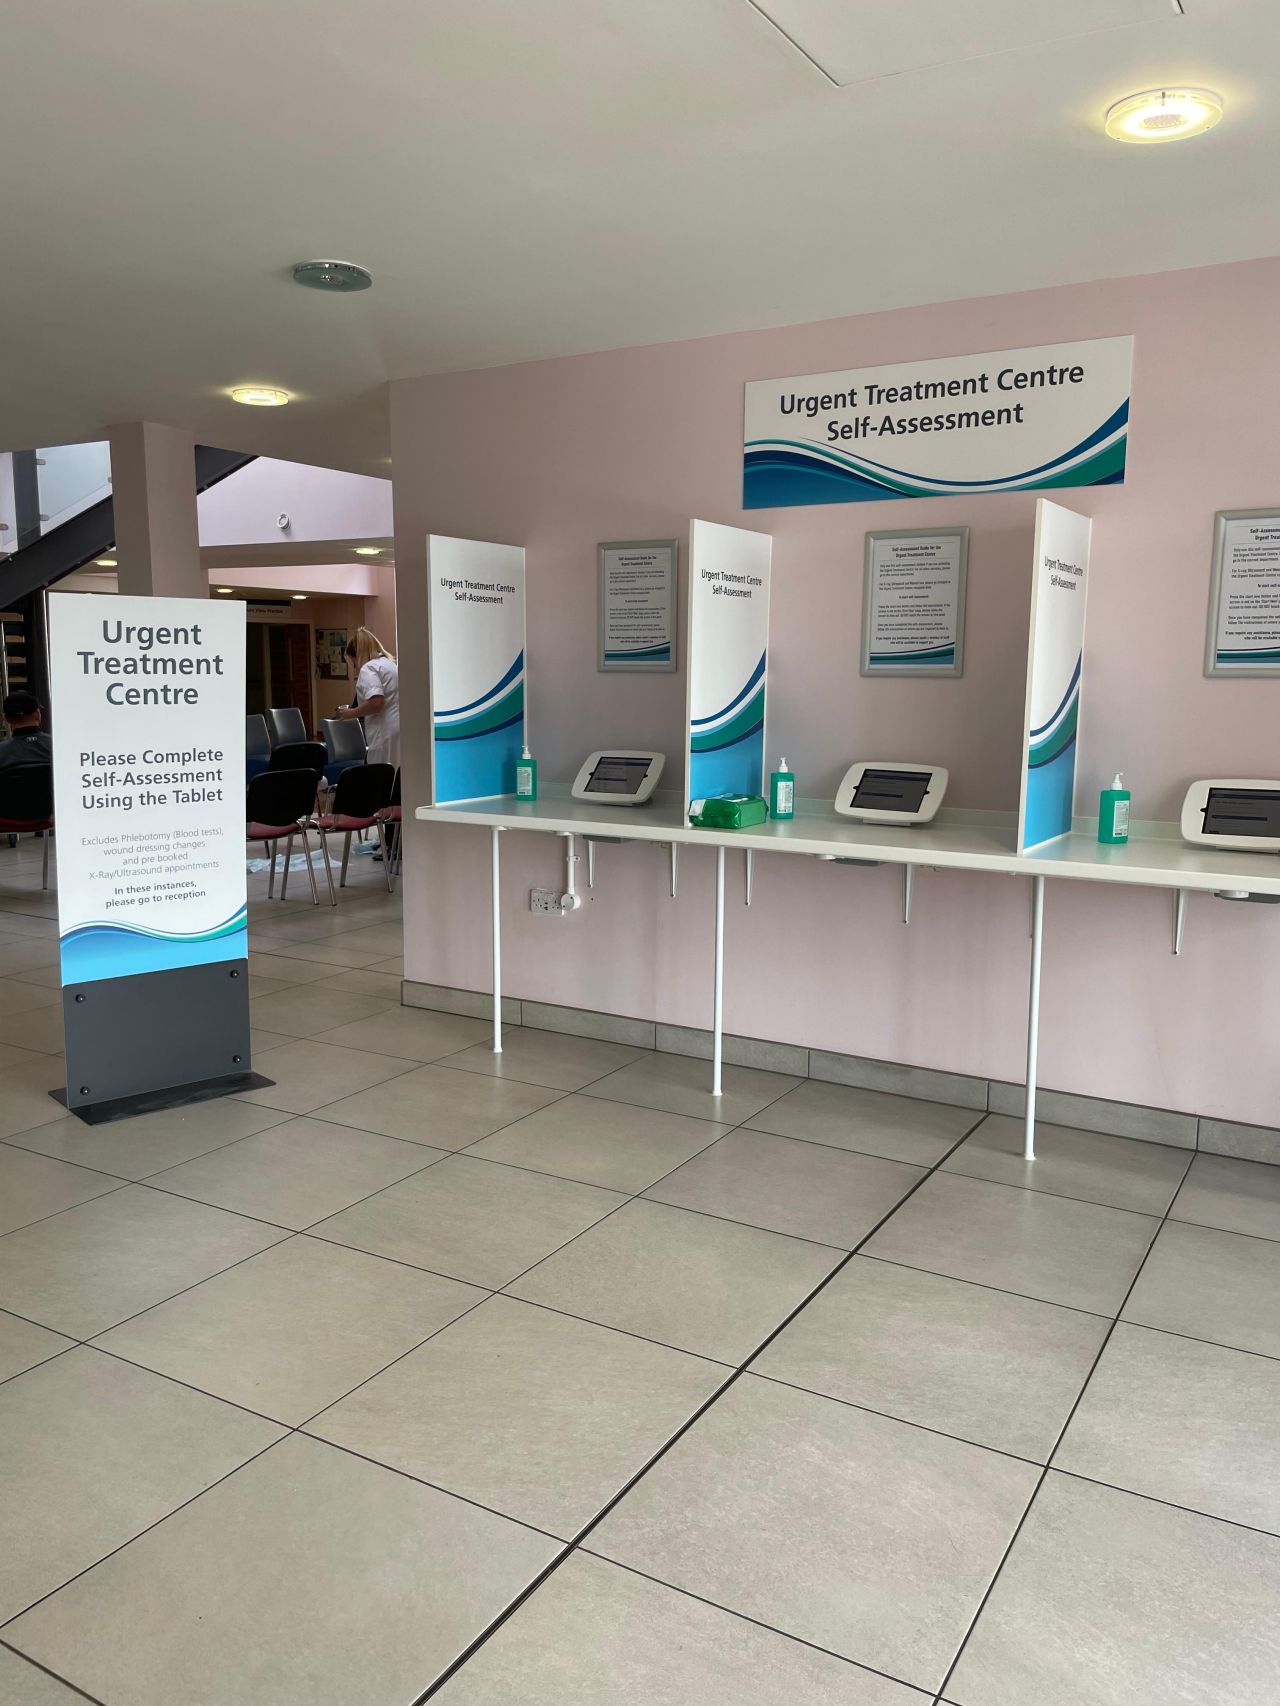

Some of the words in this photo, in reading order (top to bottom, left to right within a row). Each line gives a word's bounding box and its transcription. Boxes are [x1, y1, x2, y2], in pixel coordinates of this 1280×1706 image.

[780, 388, 857, 417] Urgent
[865, 373, 988, 406] Treatment
[996, 365, 1085, 391] Centre
[827, 403, 1024, 441] Self-Assessment
[1044, 555, 1056, 570] Urgent
[1057, 560, 1073, 573] Treatment
[1073, 564, 1083, 576] Centre
[440, 578, 463, 589] Urgent
[465, 580, 495, 591] Treatment
[496, 584, 515, 593] Centre
[701, 569, 720, 581] Urgent
[721, 572, 746, 584] Treatment
[747, 576, 762, 586] Centre
[1051, 575, 1076, 590] Self-Assessment
[454, 592, 503, 604] Self-Assessment
[712, 585, 752, 598] Self-Assessment
[103, 620, 202, 650] Urgent
[77, 651, 223, 675] Treatment
[106, 683, 198, 705] Centre
[80, 751, 136, 766] Please
[142, 748, 223, 765] Complete
[81, 769, 222, 788] Self-Assessment
[82, 793, 132, 810] Using
[139, 791, 167, 805] the
[172, 788, 222, 803] Tablet
[82, 836, 118, 846] Excludes
[121, 832, 170, 843] Phlebotomy
[173, 828, 198, 839] (Blood
[201, 827, 223, 836] tests),
[103, 845, 133, 856] wound
[136, 842, 170, 852] dressing
[172, 840, 205, 850] changes
[122, 857, 138, 865] and
[141, 858, 155, 867] pre
[157, 852, 188, 862] booked
[89, 867, 162, 880] X-Ray/Ultrasound
[165, 861, 219, 873] appointments
[114, 887, 123, 895] In
[126, 884, 151, 893] these
[154, 880, 197, 891] instances,
[105, 898, 135, 909] please
[138, 897, 149, 905] go
[165, 890, 206, 901] reception
